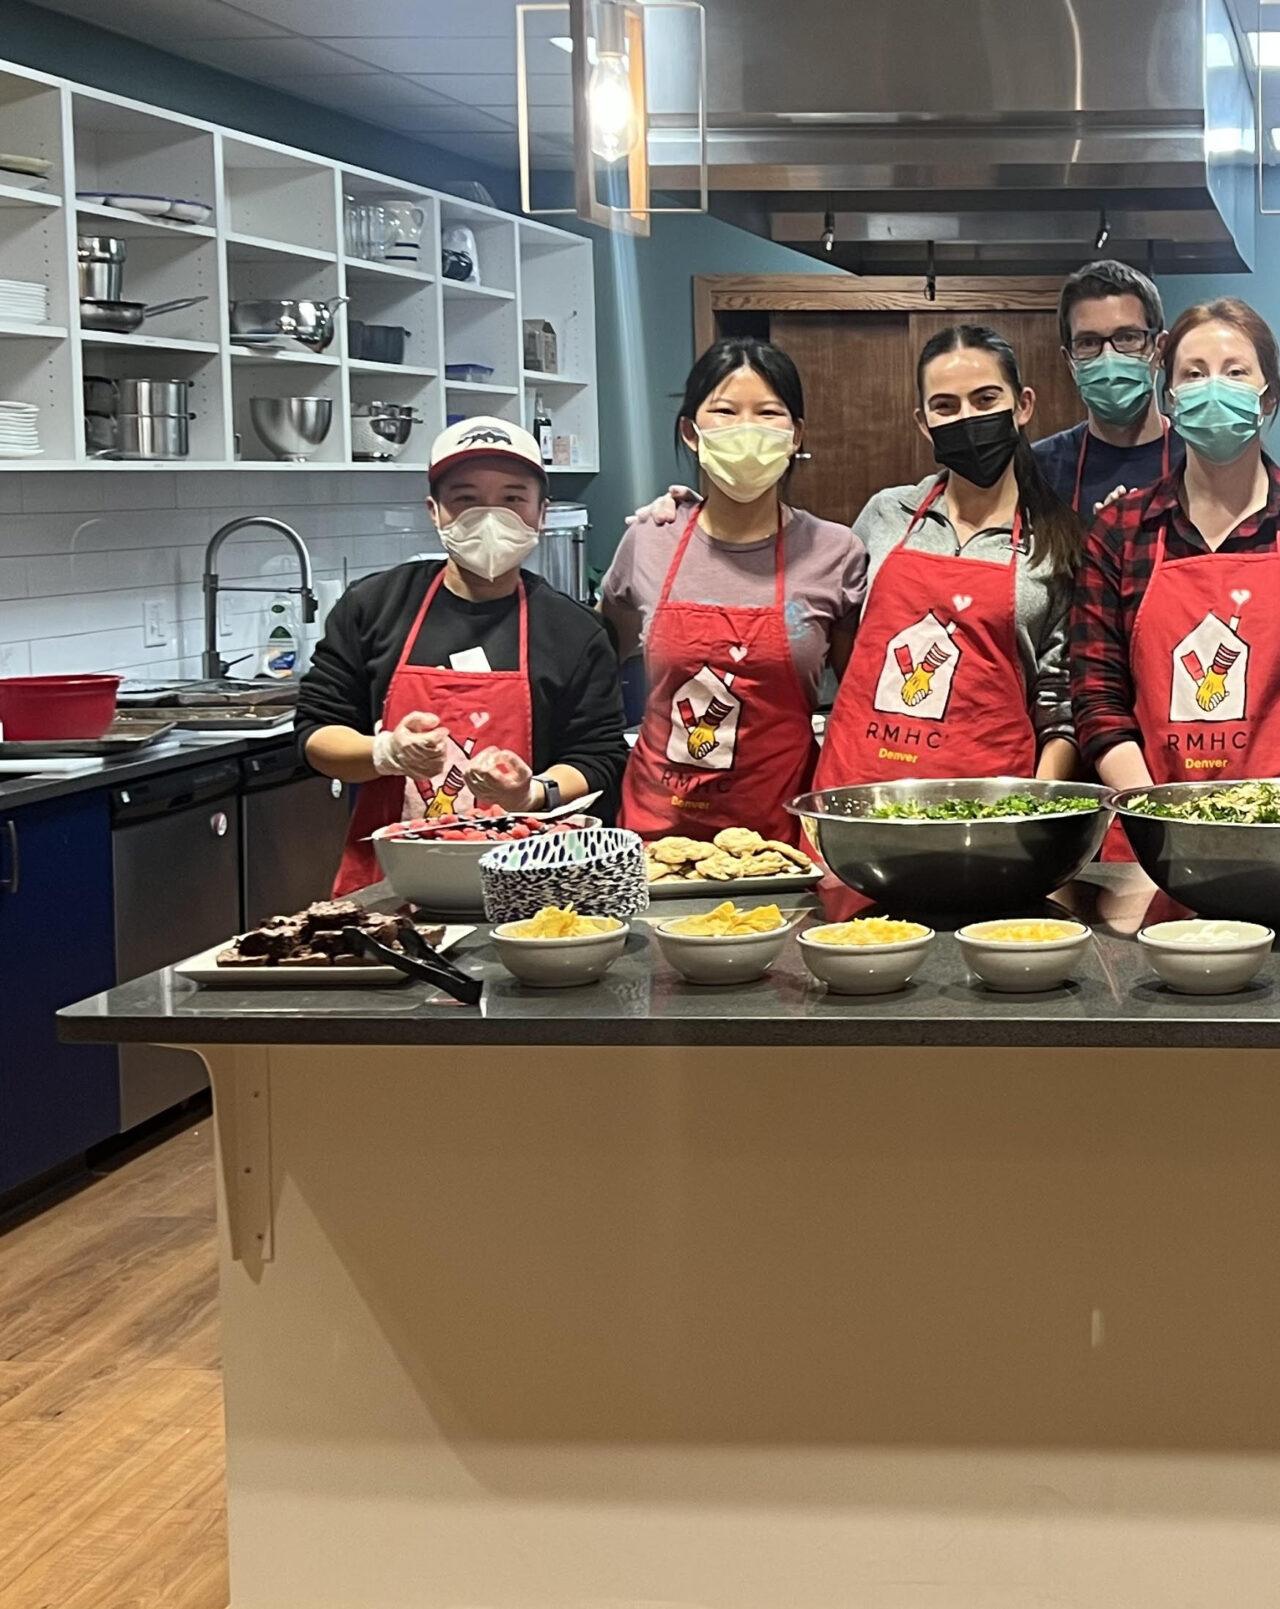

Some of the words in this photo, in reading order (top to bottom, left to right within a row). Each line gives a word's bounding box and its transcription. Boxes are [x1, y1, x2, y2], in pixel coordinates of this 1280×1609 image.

[866, 721, 942, 749] RMHC
[1167, 731, 1247, 751] RMHC
[878, 747, 919, 764] Denver
[1184, 757, 1228, 769] Denver
